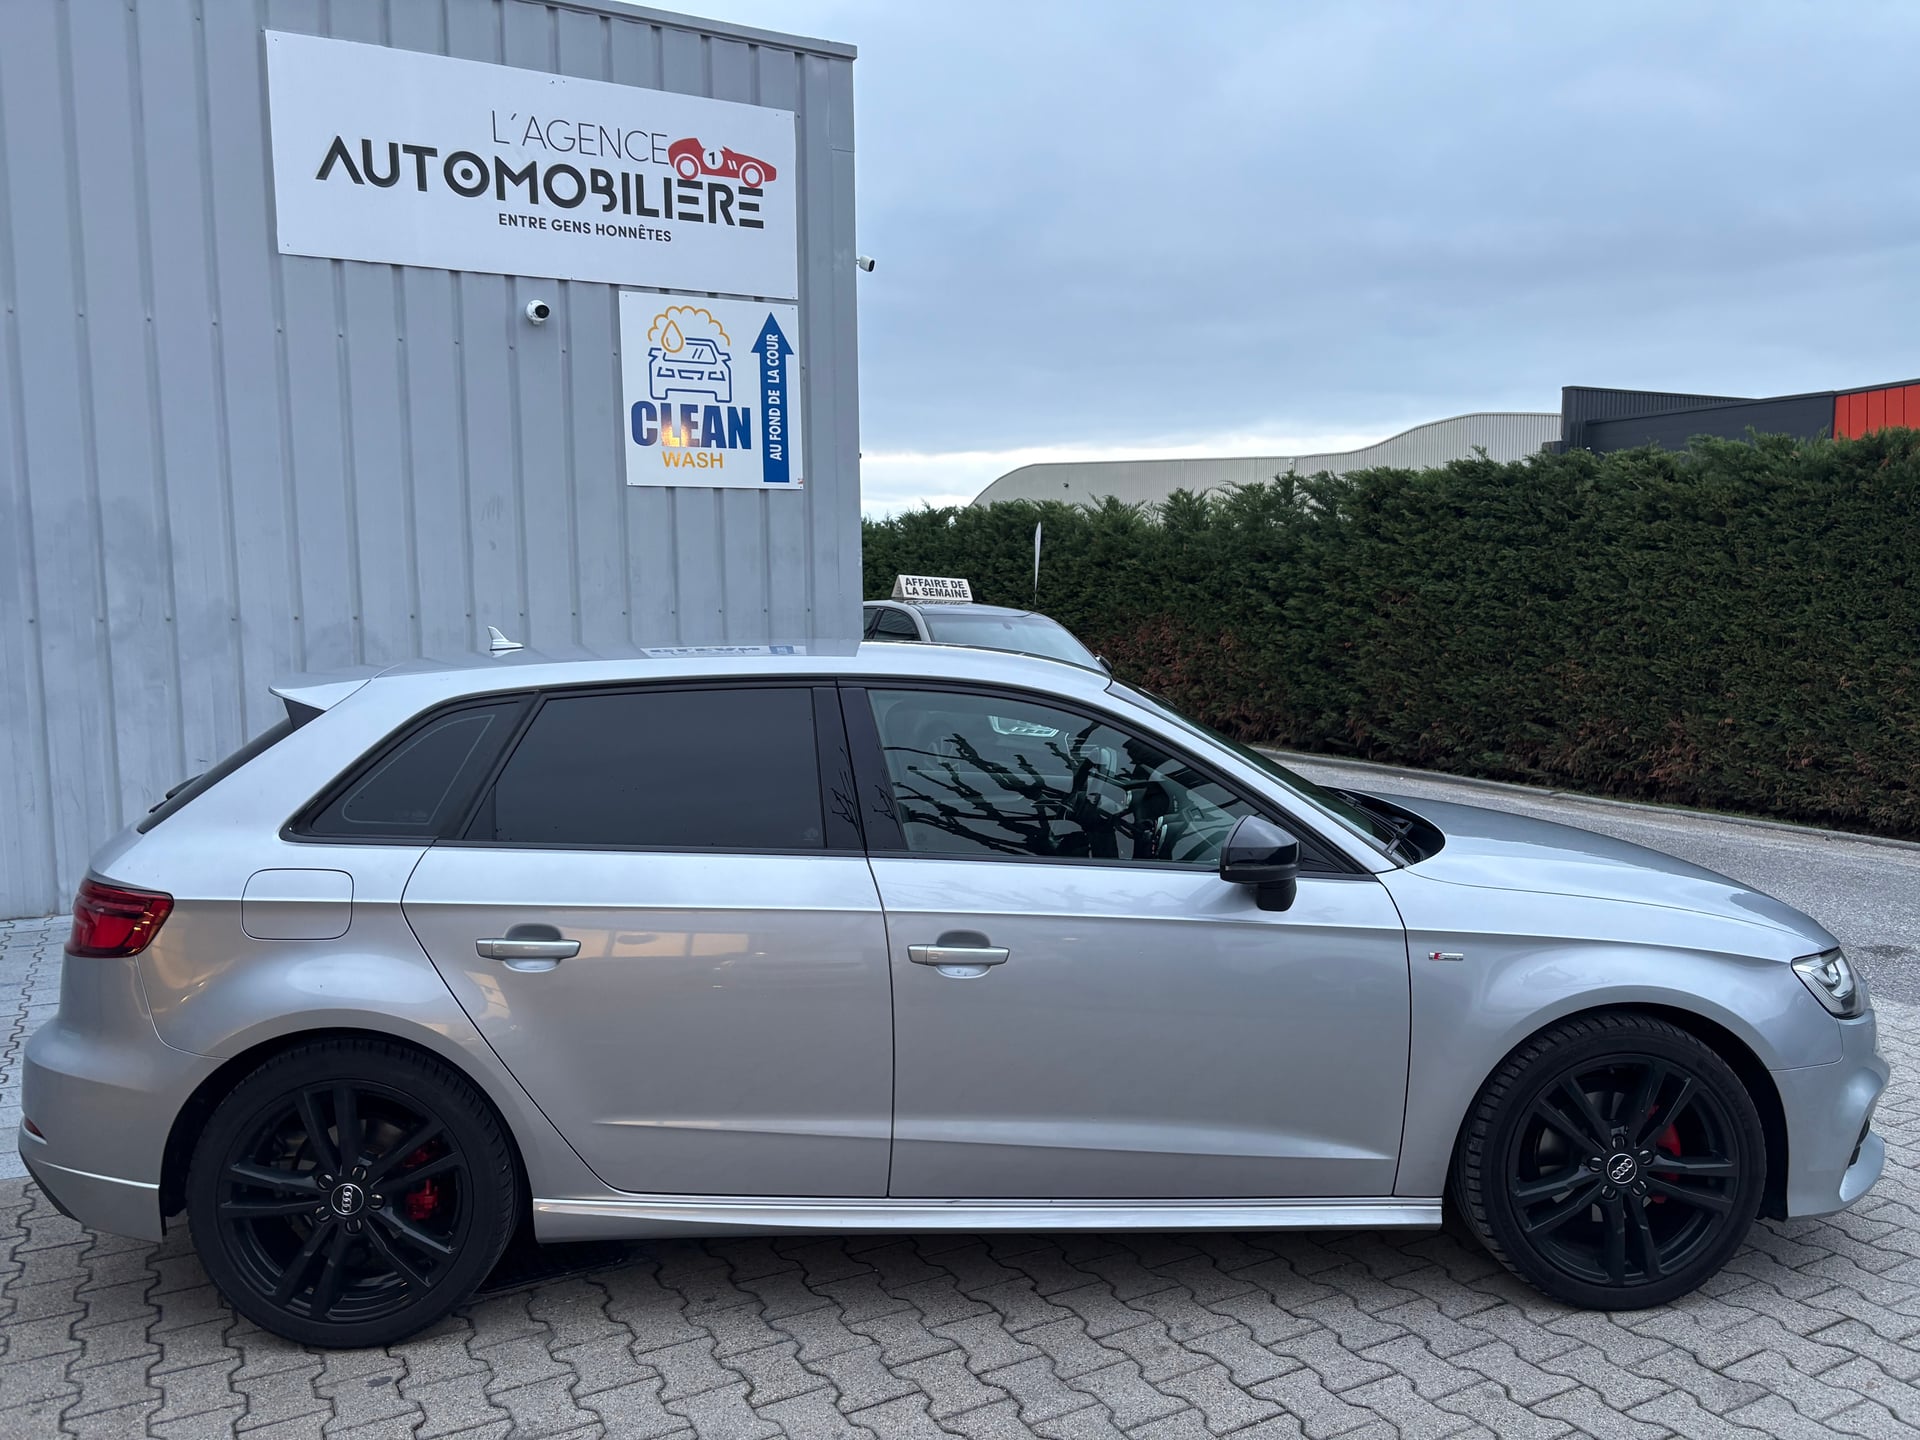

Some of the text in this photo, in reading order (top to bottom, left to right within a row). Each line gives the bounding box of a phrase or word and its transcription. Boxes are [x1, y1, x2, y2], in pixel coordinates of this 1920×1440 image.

[708, 151, 716, 165] 1
[498, 213, 672, 242] ENTRE GENS HONNÊTES
[766, 334, 782, 461] AU FOND DE LA COUR
[631, 400, 752, 450] CLEAN
[662, 450, 724, 469] WASH
[905, 578, 964, 589] AFFAIRE DE
[905, 587, 968, 598] LA SEMAINE
